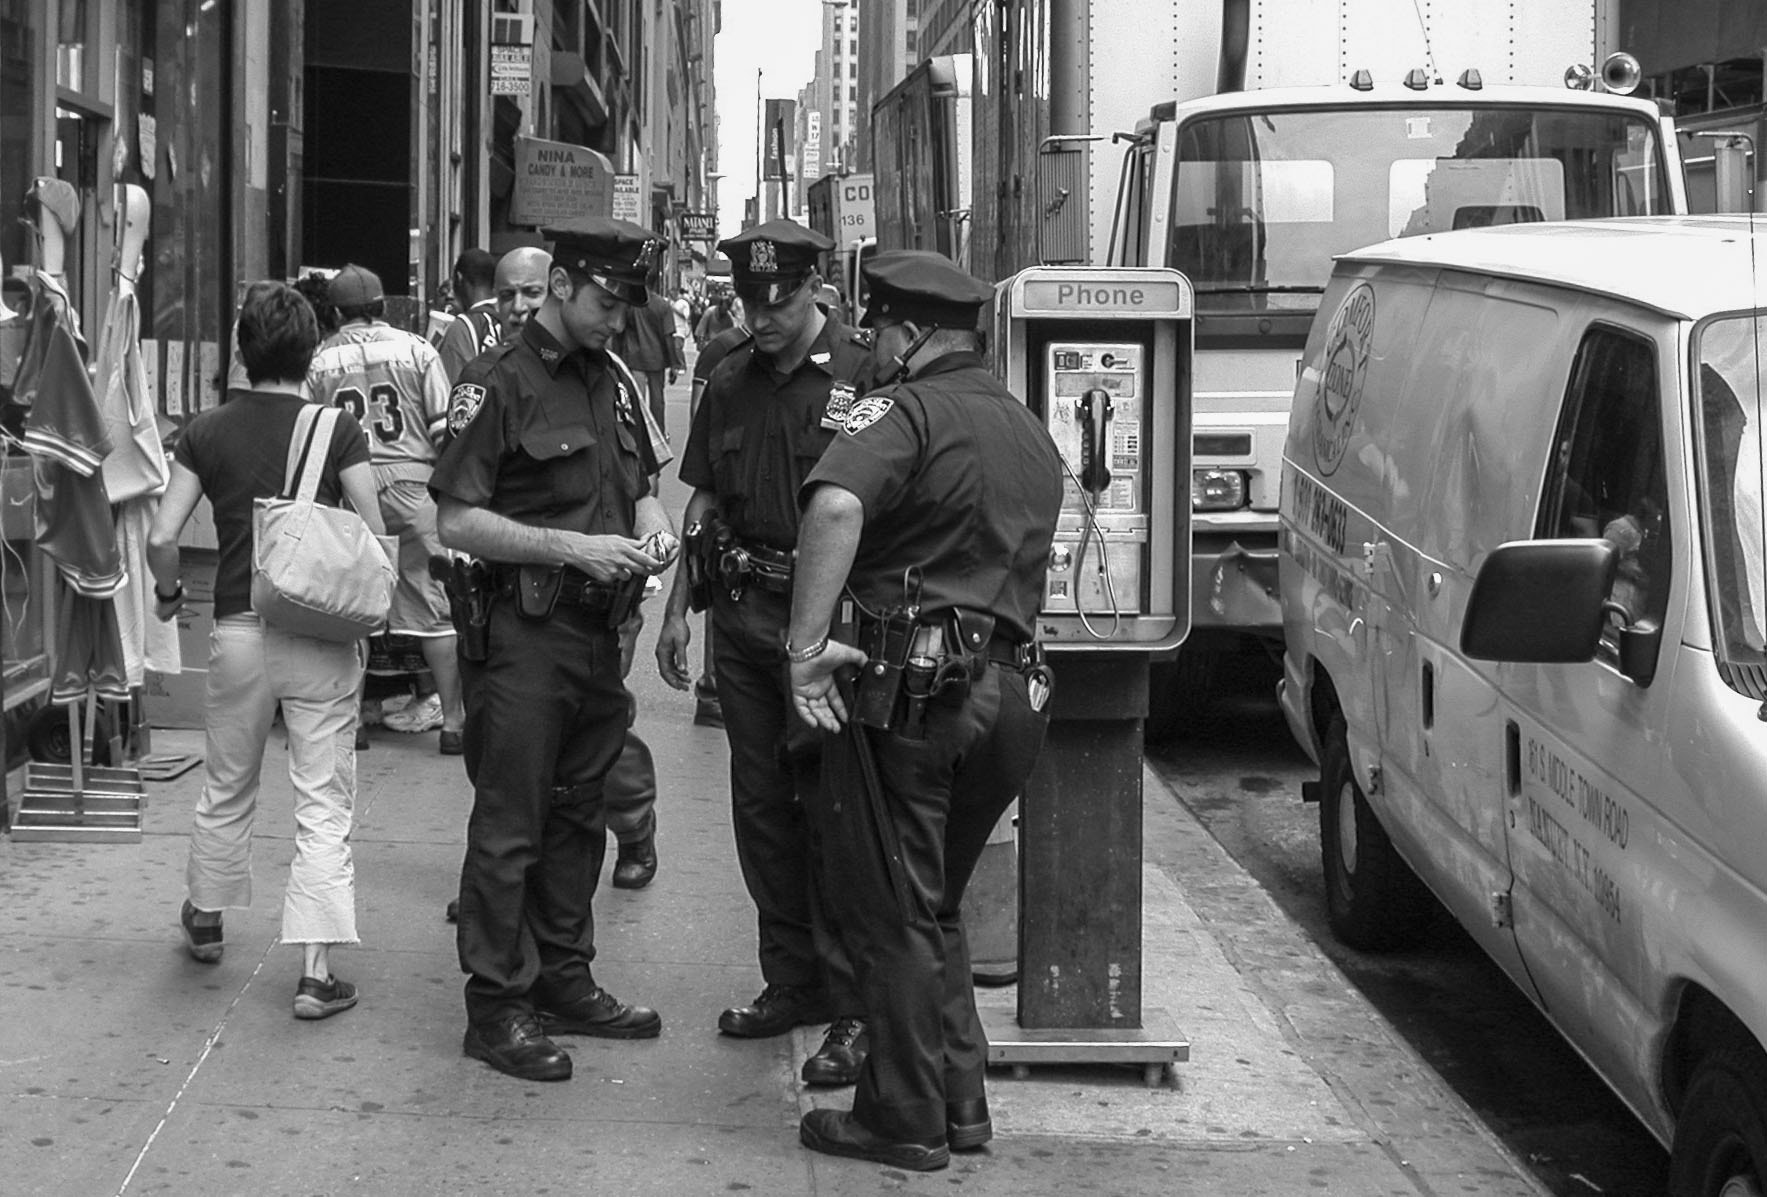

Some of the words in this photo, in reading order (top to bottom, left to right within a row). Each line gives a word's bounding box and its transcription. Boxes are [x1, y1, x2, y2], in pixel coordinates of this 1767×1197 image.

[538, 149, 575, 164] NINA
[528, 163, 556, 177] CANDY
[570, 166, 594, 179] MORE
[841, 214, 865, 227] 136
[1057, 284, 1145, 305] Phone
